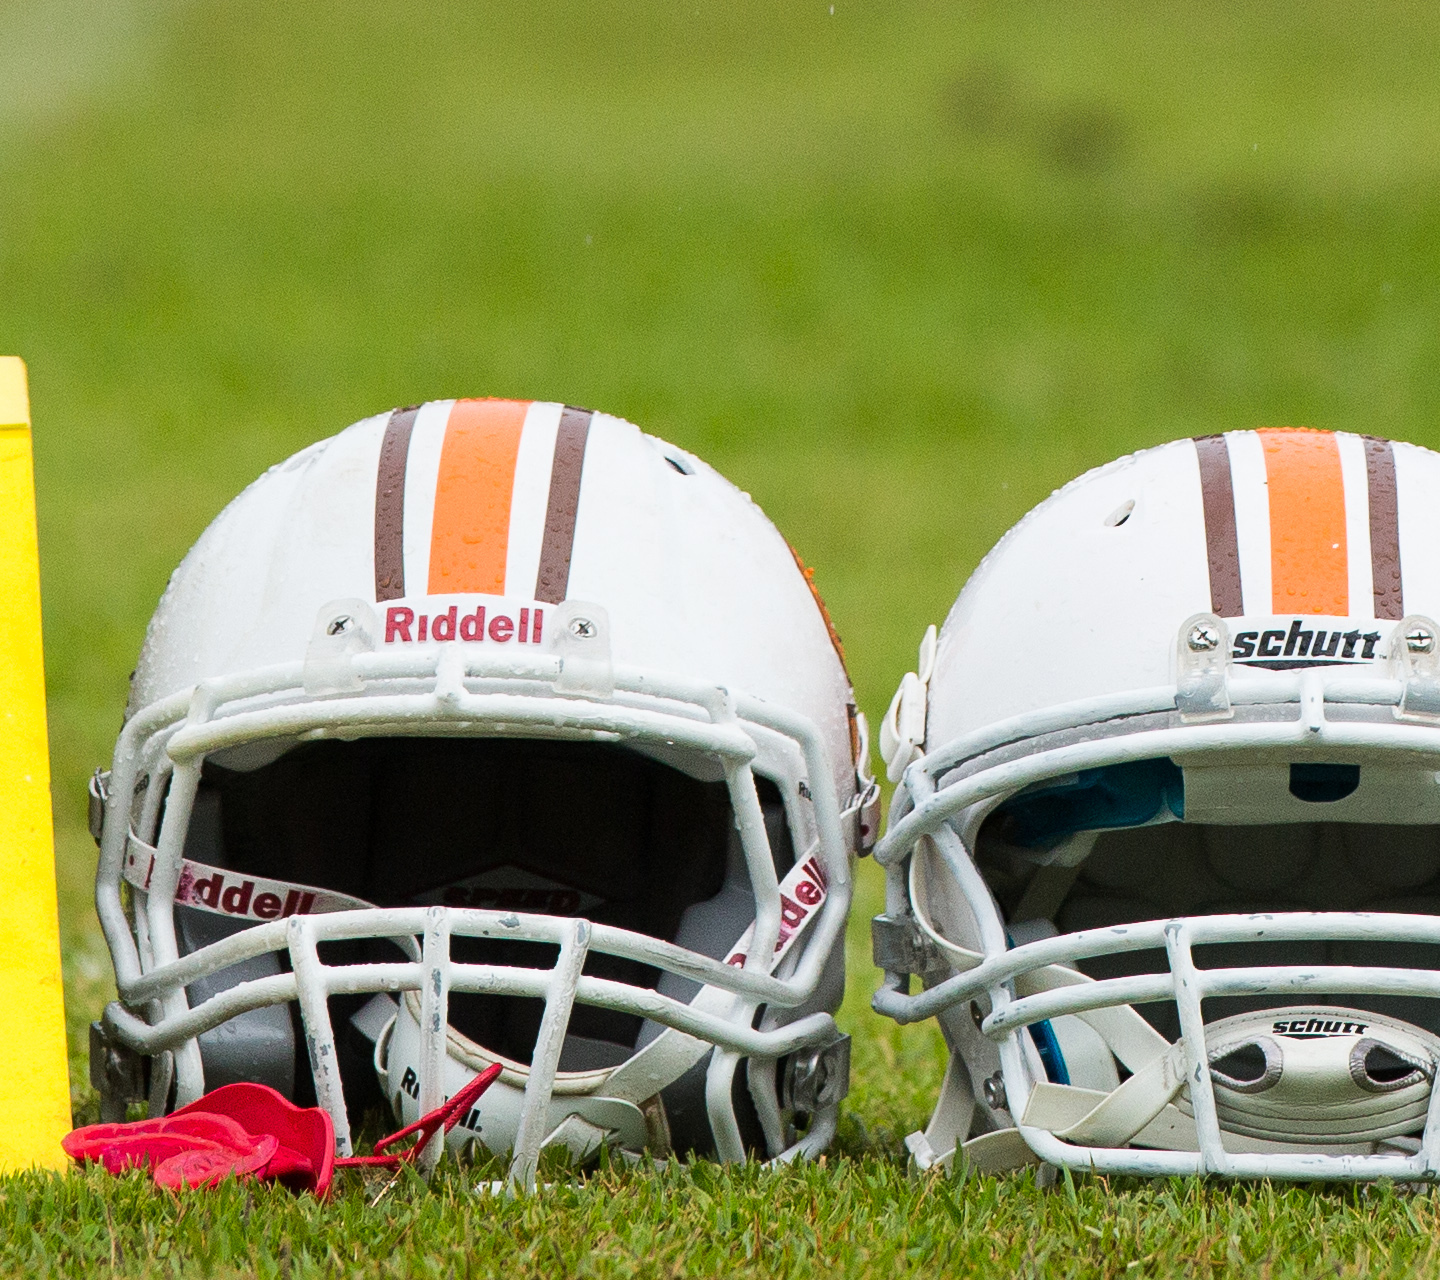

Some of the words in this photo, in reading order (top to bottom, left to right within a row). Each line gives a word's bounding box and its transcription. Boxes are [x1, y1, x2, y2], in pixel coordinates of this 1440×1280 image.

[385, 606, 543, 644] Riddell
[1233, 620, 1381, 659] schutt
[145, 854, 316, 920] iddell
[1272, 1018, 1369, 1035] schutt
